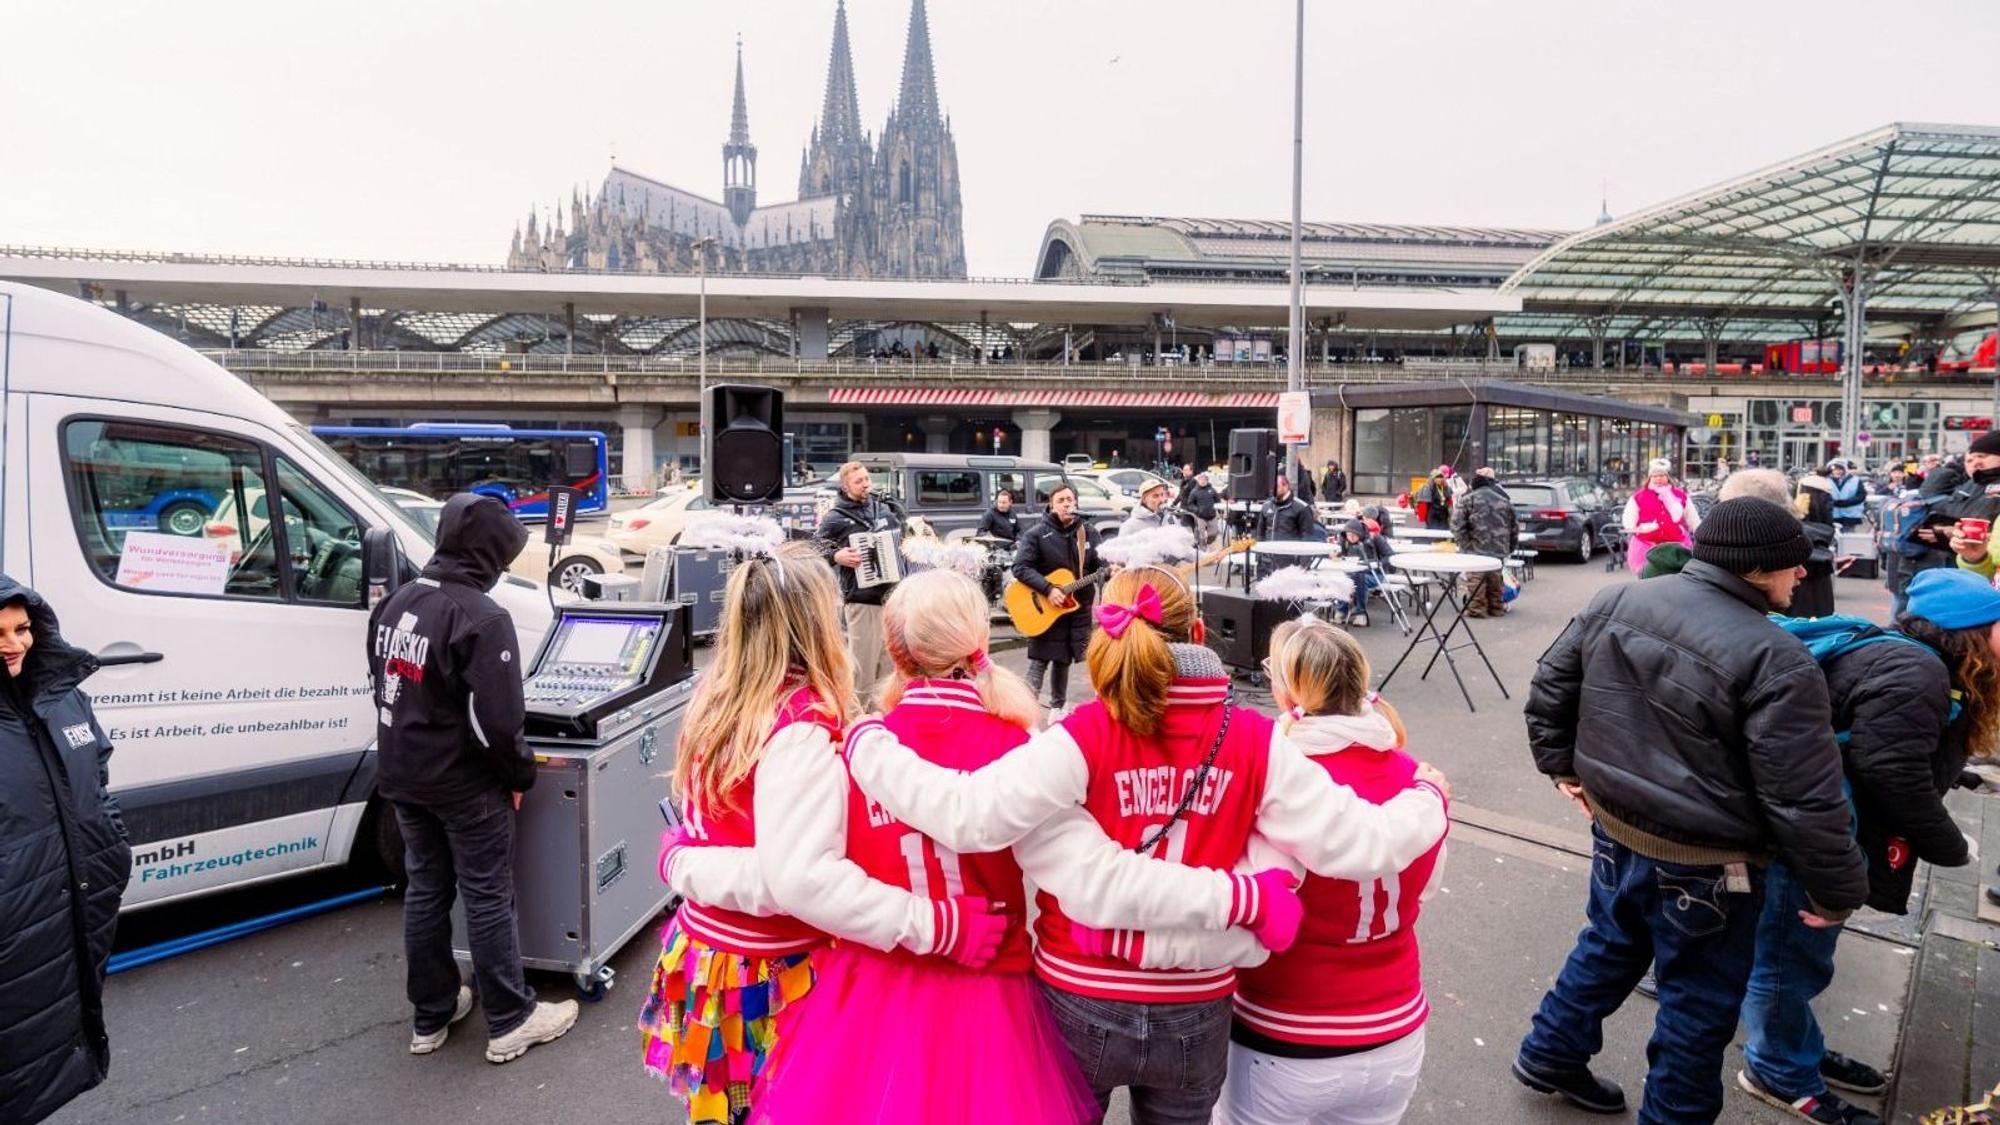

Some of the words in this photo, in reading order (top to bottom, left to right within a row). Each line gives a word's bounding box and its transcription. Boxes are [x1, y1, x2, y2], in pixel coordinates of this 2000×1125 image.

[89, 691, 155, 704] renamt
[158, 690, 178, 701] ist
[181, 689, 223, 701] keine
[226, 687, 271, 700] Arbeit
[274, 687, 296, 698] die
[299, 685, 349, 697] bezahlt
[351, 685, 374, 696] wir
[109, 727, 126, 740] Es
[131, 727, 150, 739] ist
[154, 725, 207, 738] Arbeit,
[210, 723, 234, 735] die
[238, 719, 325, 733] unbezahlbar
[328, 717, 349, 728] ist!
[134, 840, 196, 866] mbH
[141, 836, 319, 882] Fahrzeugtechnik
